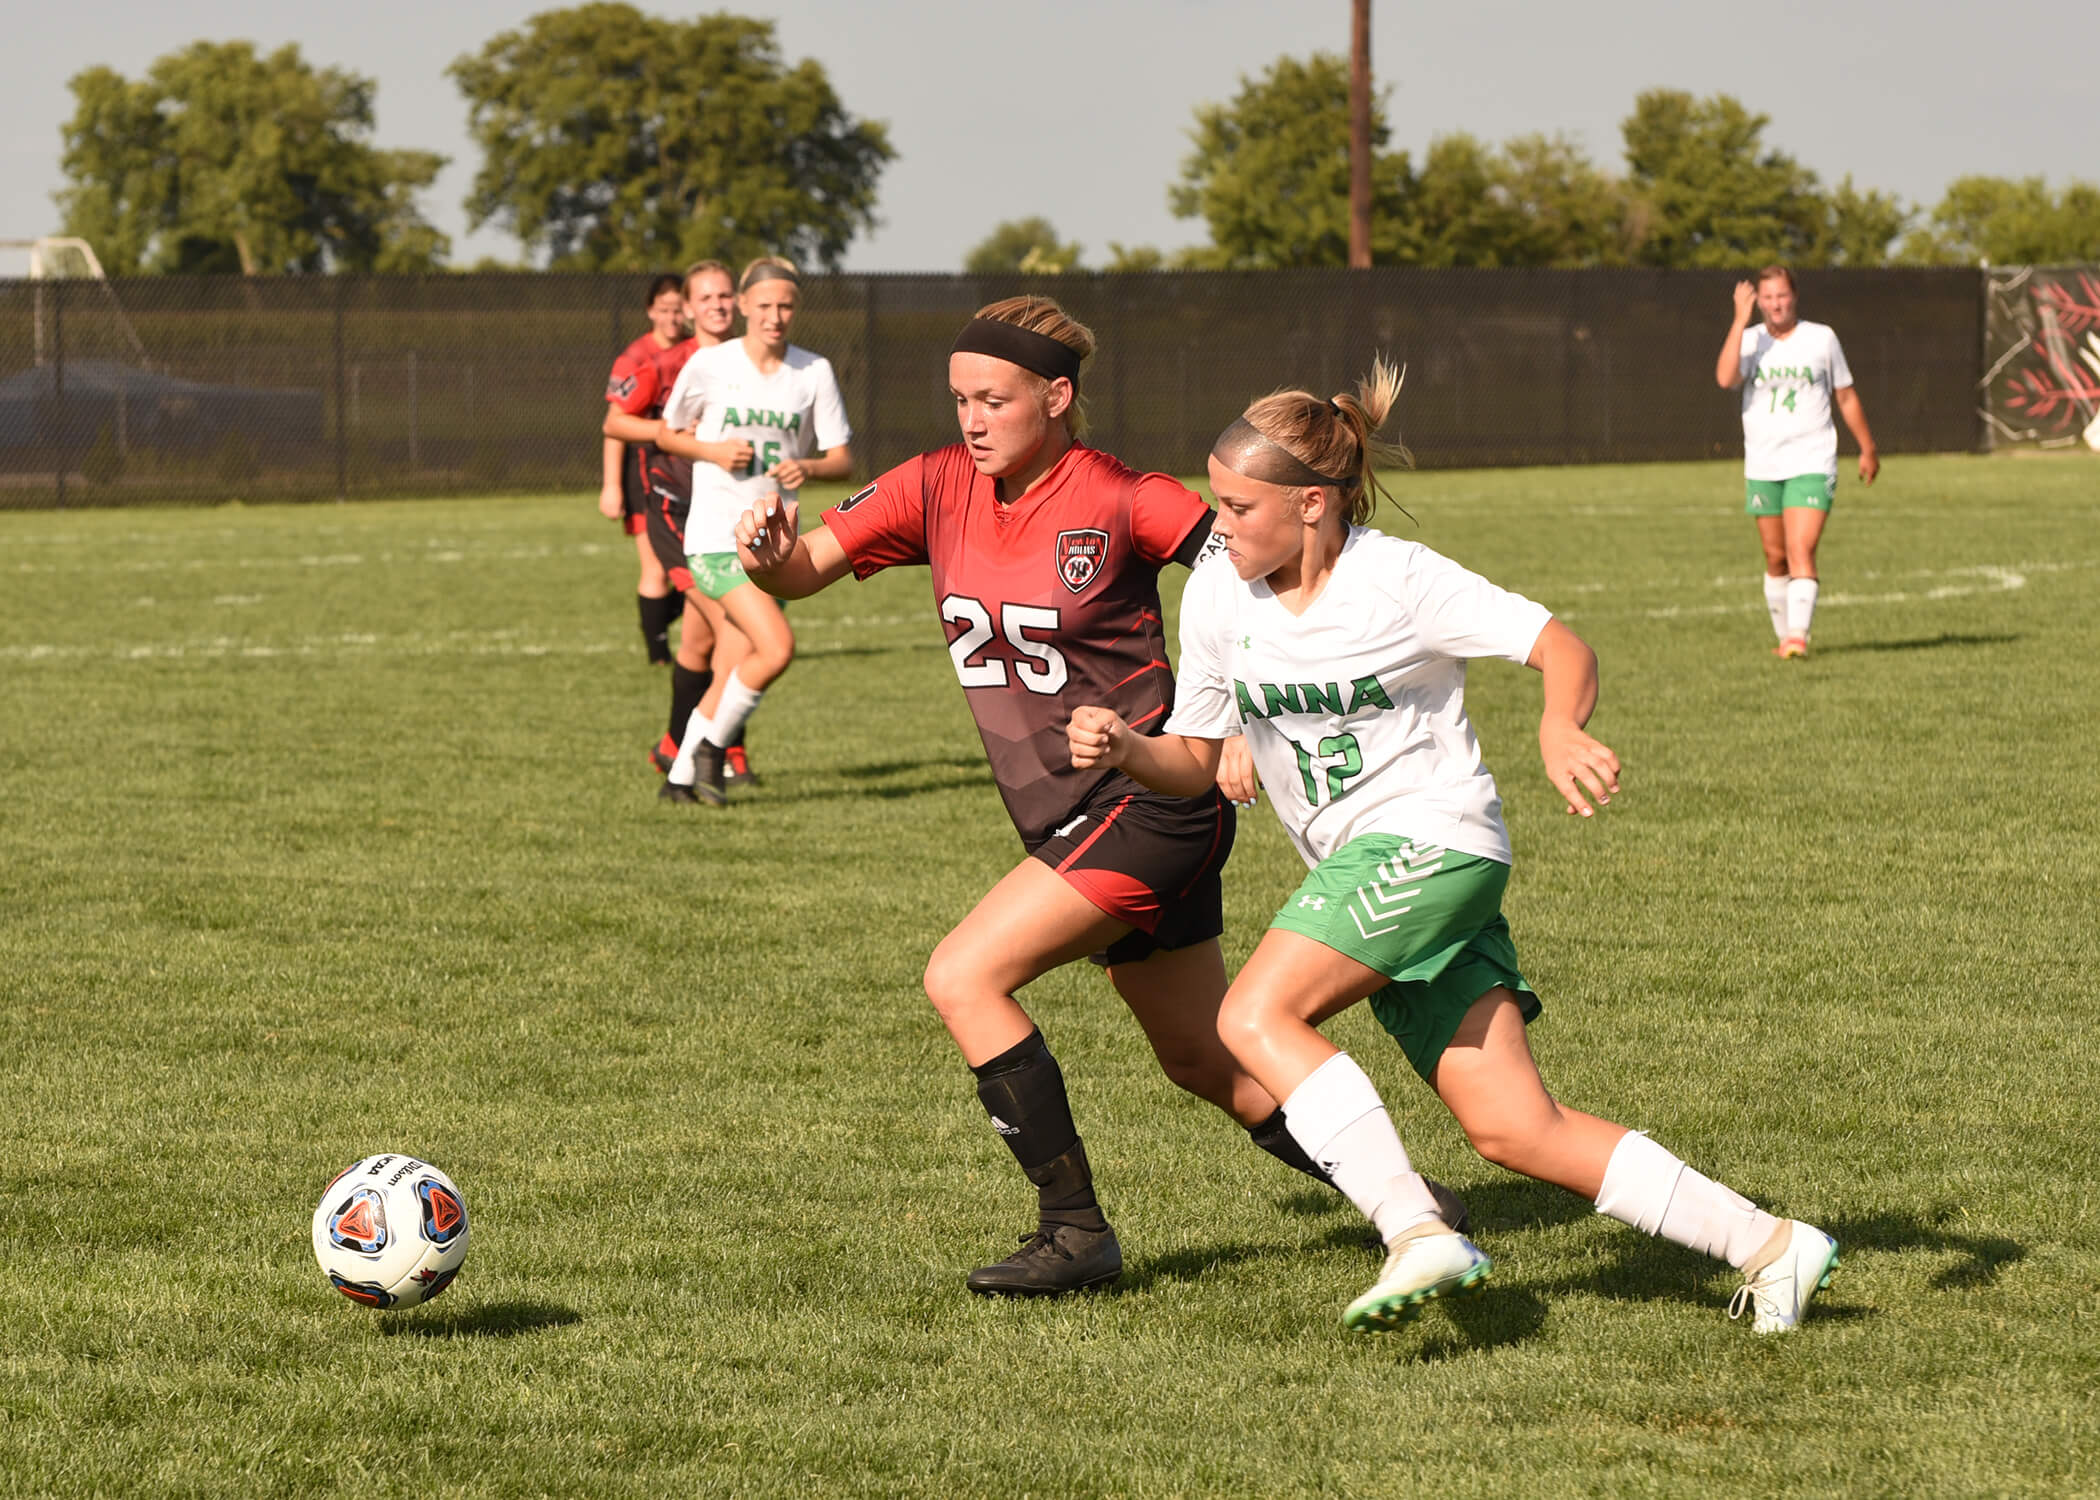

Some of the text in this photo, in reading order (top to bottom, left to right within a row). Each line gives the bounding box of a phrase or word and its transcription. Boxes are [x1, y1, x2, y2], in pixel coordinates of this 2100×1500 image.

[1752, 364, 1814, 386] ANNA
[1769, 385, 1798, 414] 14
[720, 406, 802, 438] ANNA
[940, 593, 1069, 696] 25
[1233, 674, 1395, 725] ANNA
[1289, 732, 1363, 807] 12
[387, 1160, 423, 1187] Wilson
